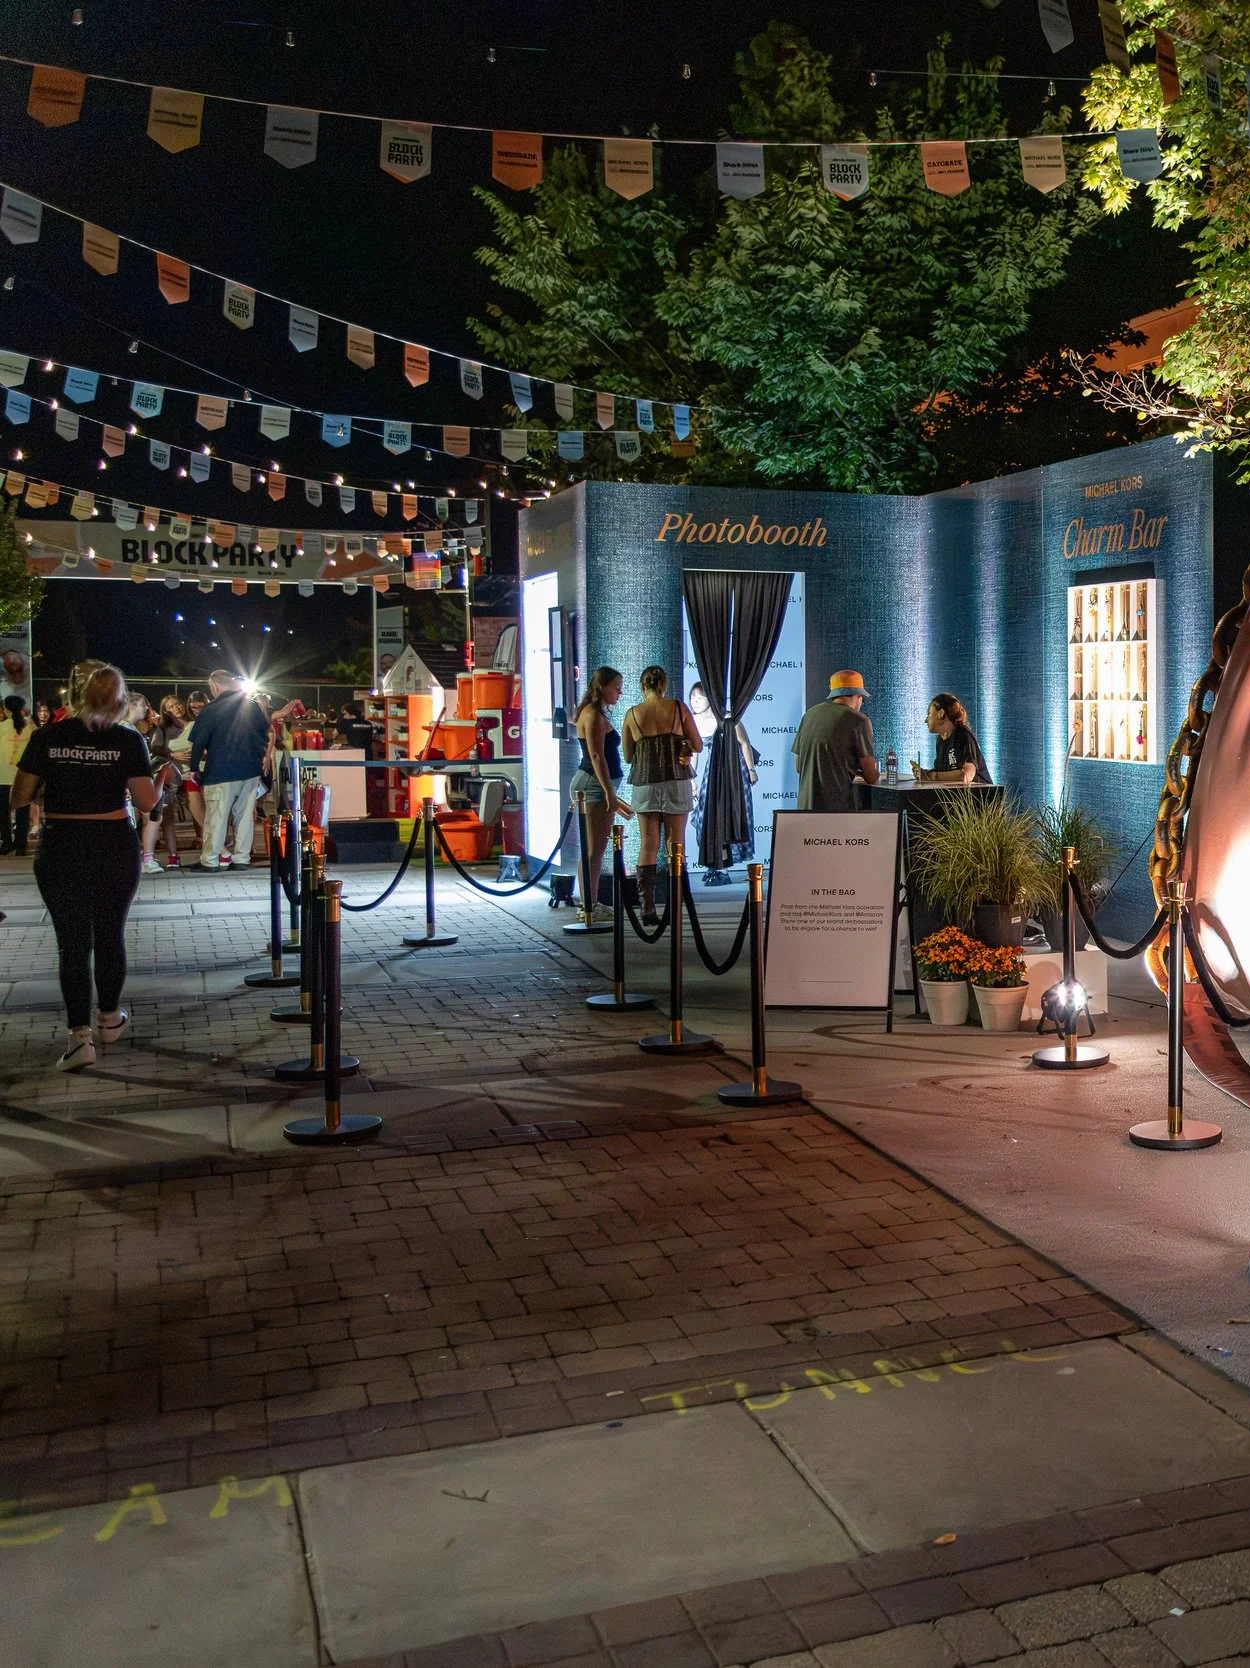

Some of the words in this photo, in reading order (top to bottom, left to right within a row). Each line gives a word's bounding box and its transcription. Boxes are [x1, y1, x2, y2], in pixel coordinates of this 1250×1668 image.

[388, 153, 423, 166] PARTY
[830, 163, 861, 173] BLOCK
[830, 174, 862, 184] PARTY
[1085, 479, 1117, 498] MICHAEL
[1120, 475, 1143, 493] KORS
[655, 513, 827, 547] Photobooth
[1063, 516, 1124, 559] Charm
[1128, 508, 1168, 550] Bar
[122, 539, 207, 565] BLOCK
[49, 747, 84, 759] BLOCK
[85, 750, 121, 761] PARTY
[803, 838, 842, 846] MICHAEL
[845, 838, 869, 846] KORS
[811, 888, 819, 896] IN
[821, 888, 837, 896] THE
[838, 888, 856, 896] BAG
